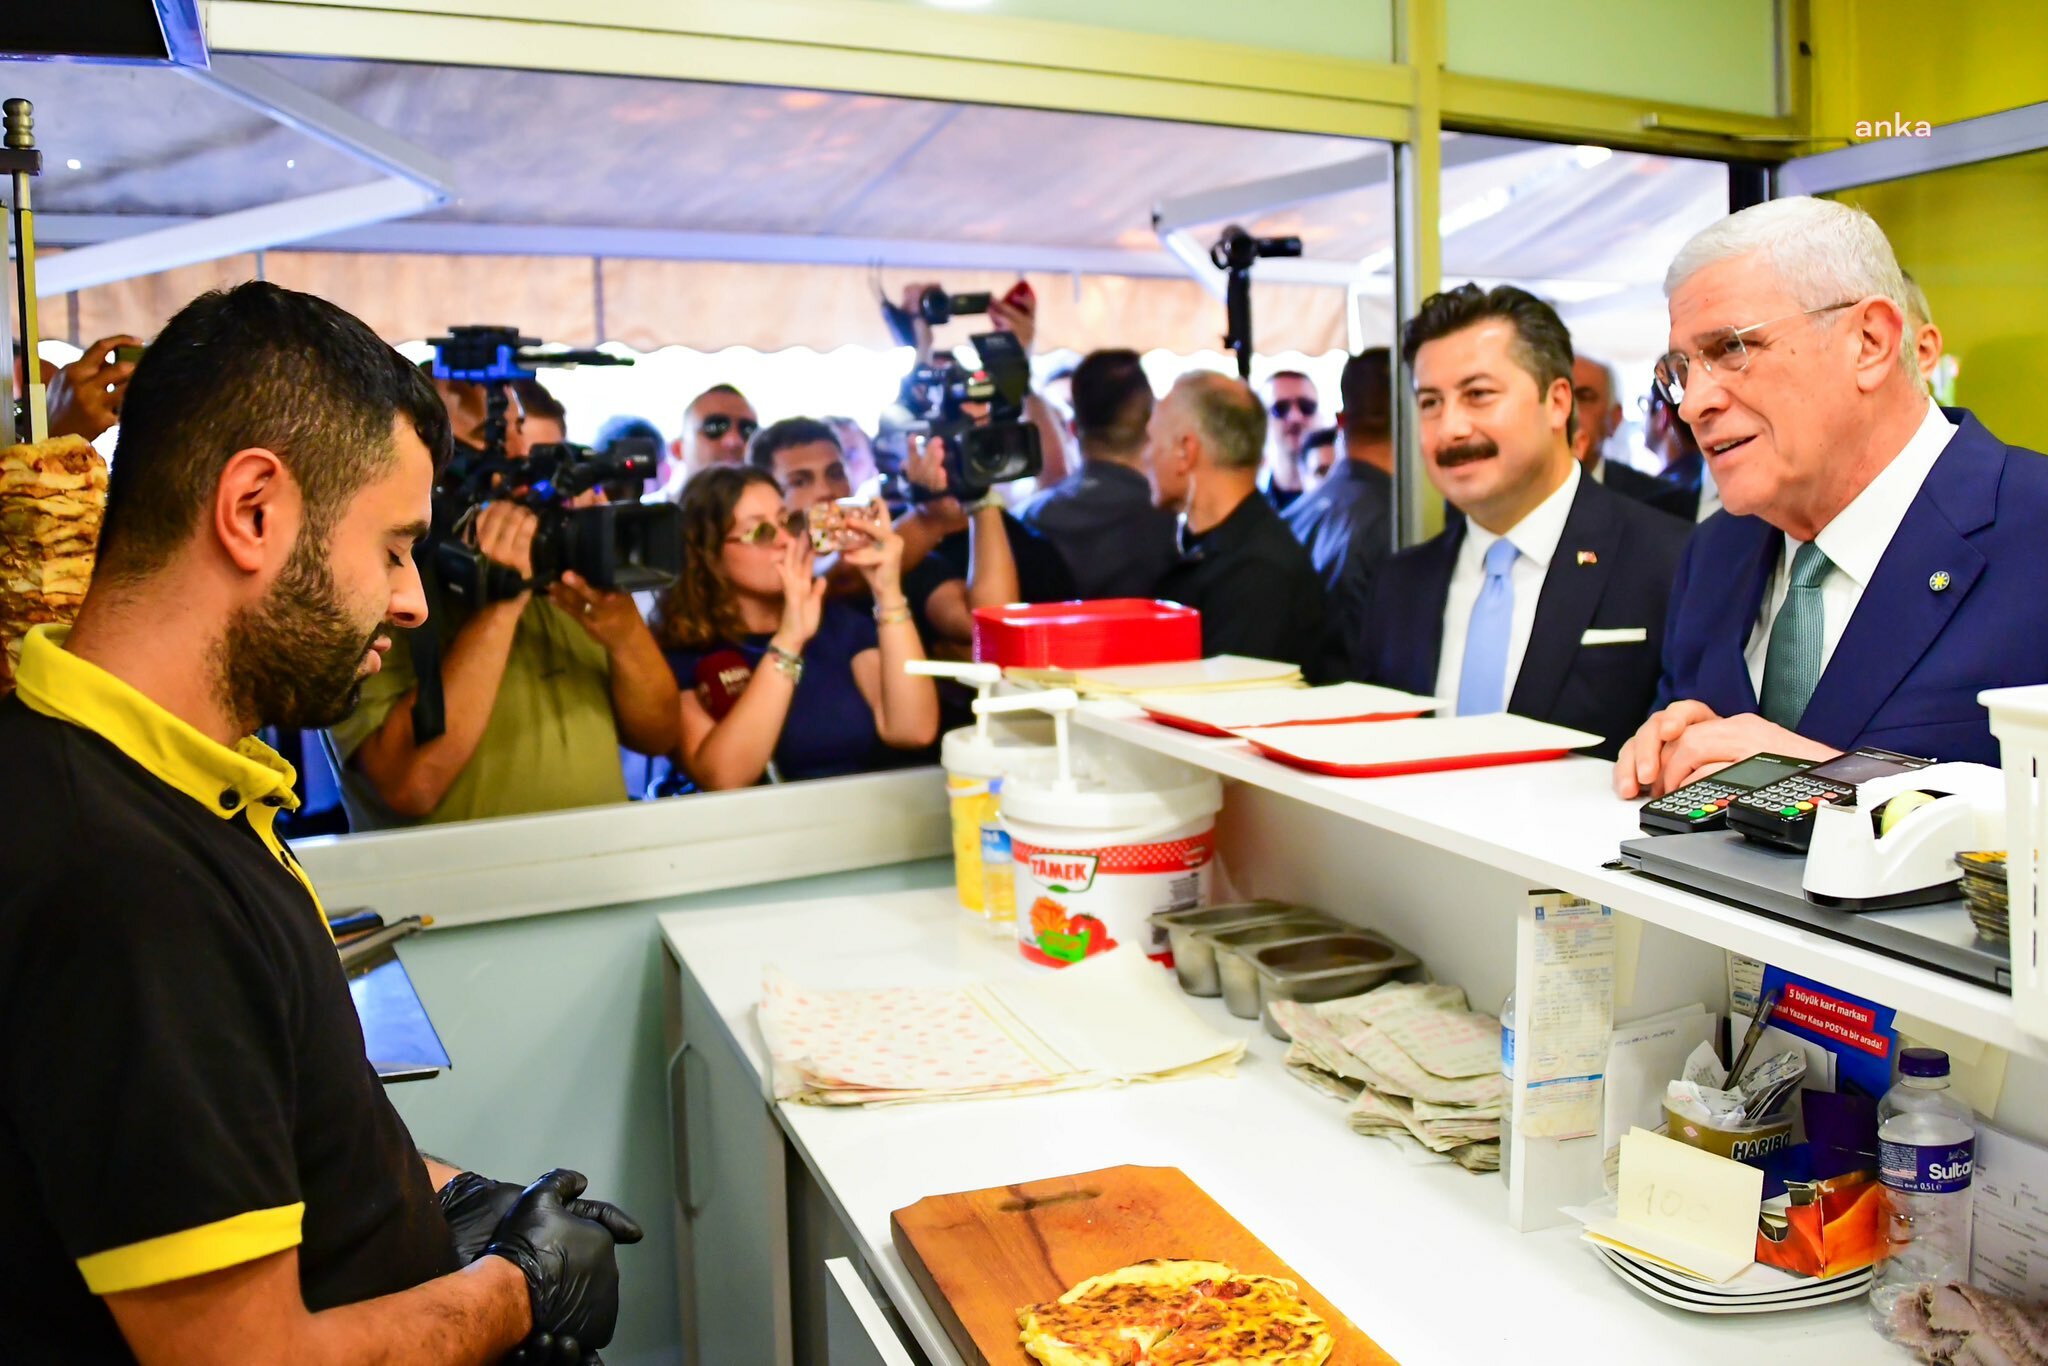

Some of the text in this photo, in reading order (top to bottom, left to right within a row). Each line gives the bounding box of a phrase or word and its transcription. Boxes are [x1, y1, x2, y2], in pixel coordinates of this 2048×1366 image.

[1032, 859, 1087, 881] TAMEK
[1789, 989, 1868, 1023] 5 büyük kart markası
[1789, 1008, 1807, 1021] Yazar
[1807, 1016, 1824, 1028] Kasa
[1825, 1021, 1848, 1037] POS'ta
[1849, 1030, 1860, 1041] bir
[1860, 1037, 1883, 1050] arada!
